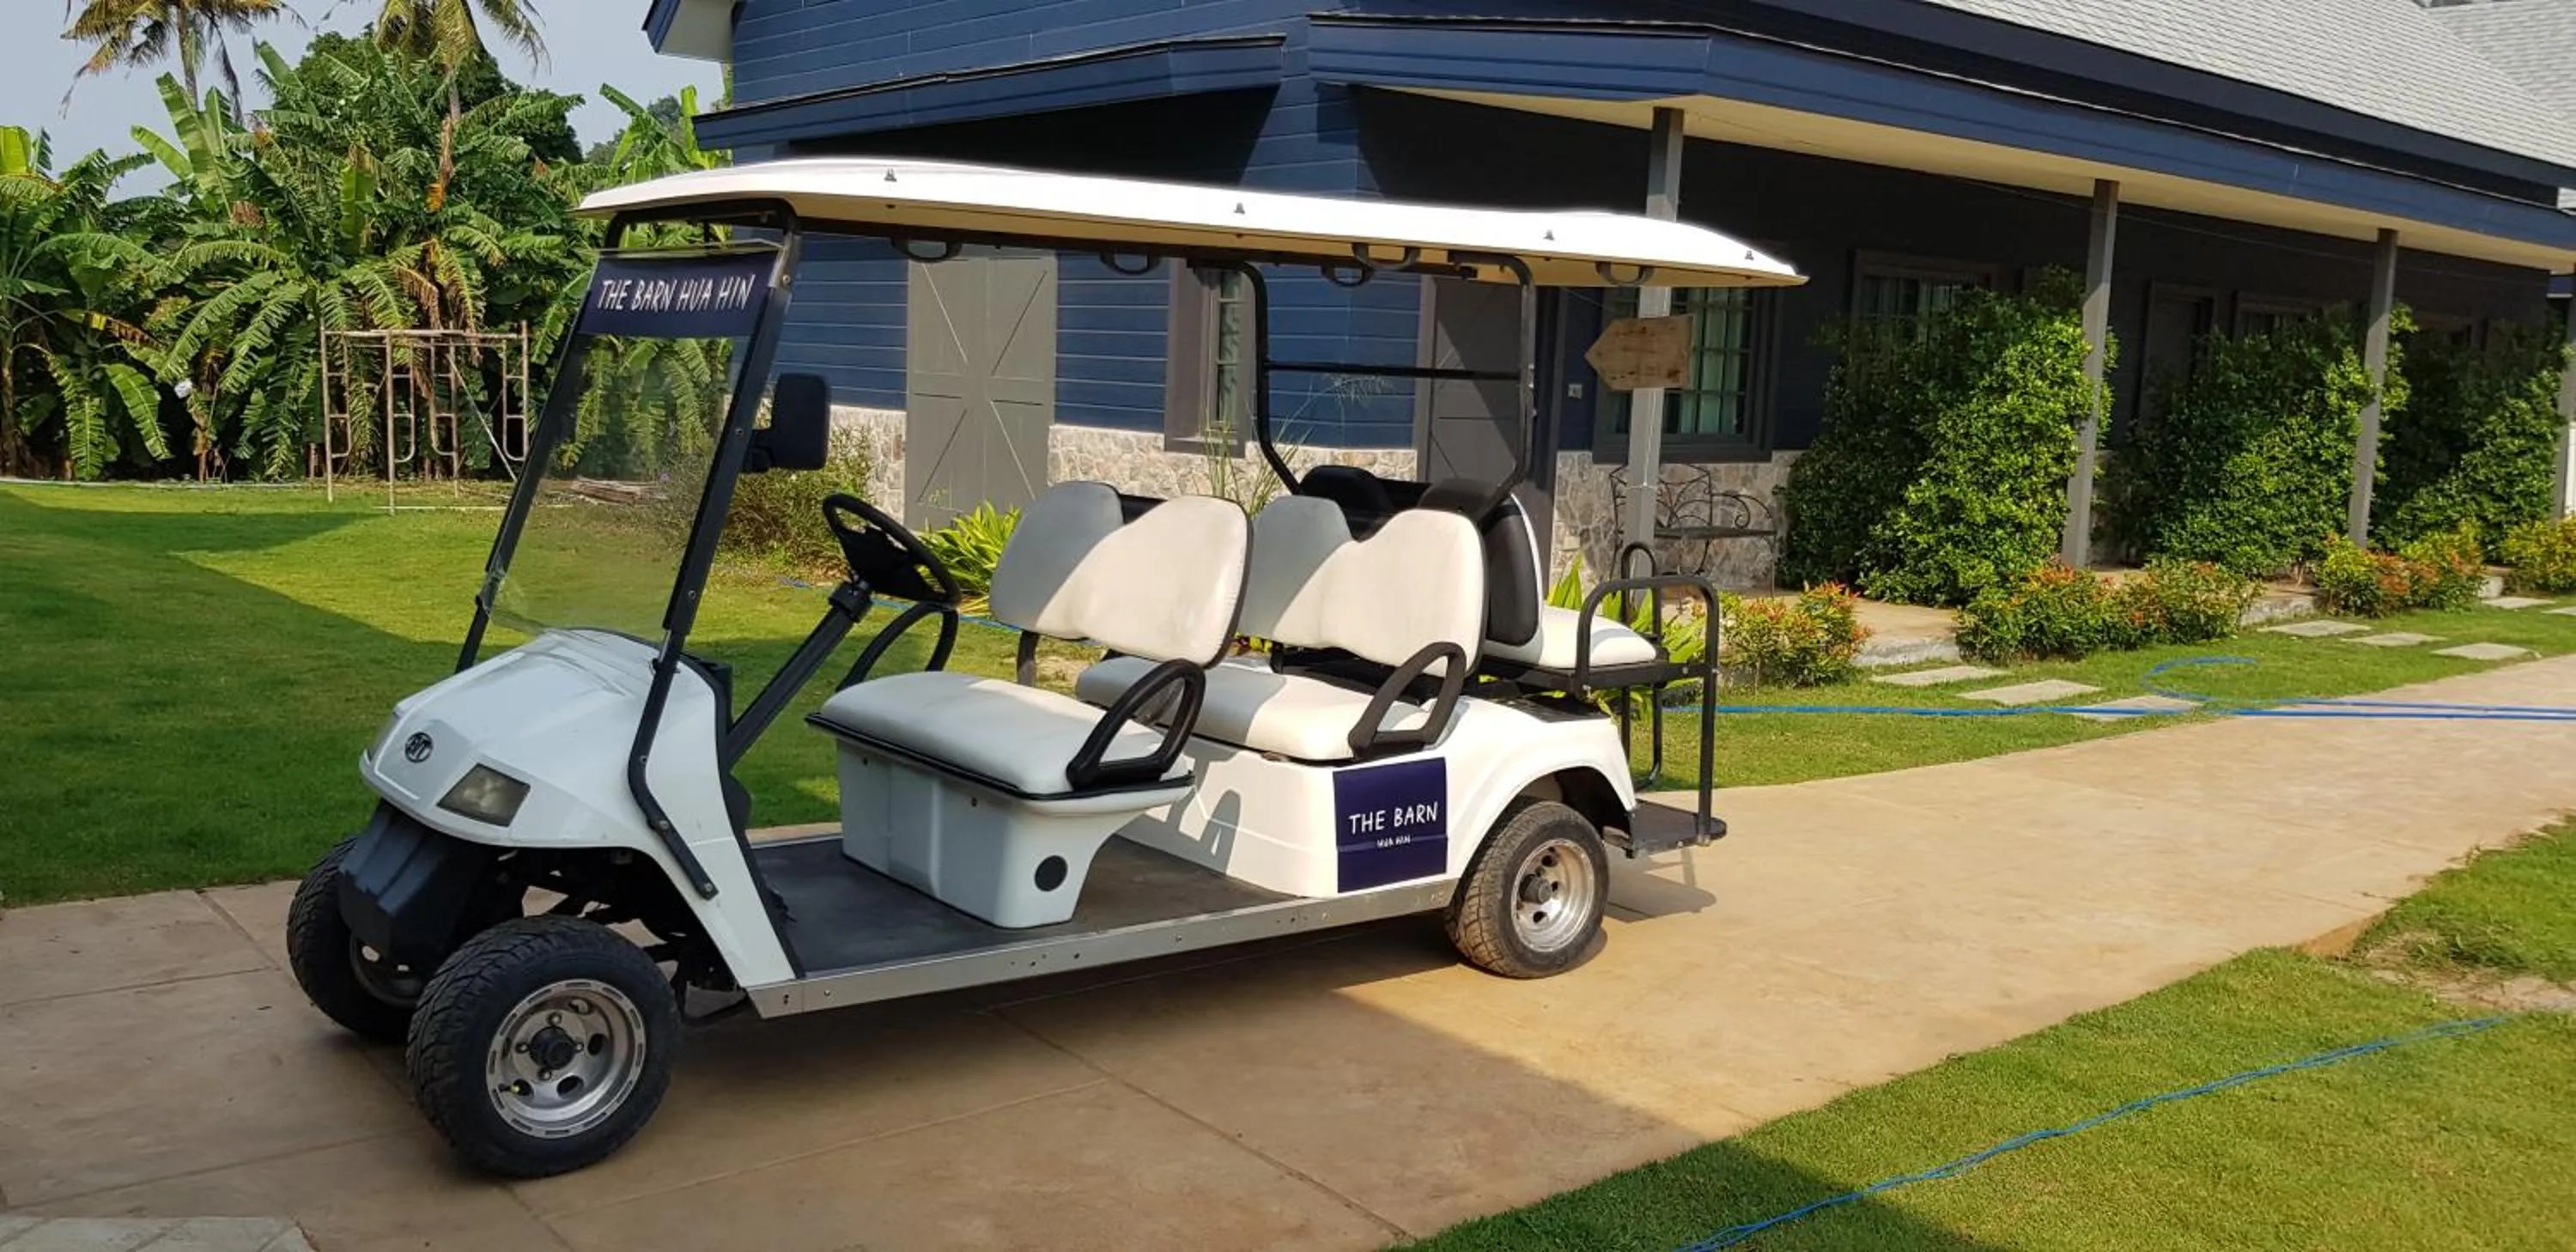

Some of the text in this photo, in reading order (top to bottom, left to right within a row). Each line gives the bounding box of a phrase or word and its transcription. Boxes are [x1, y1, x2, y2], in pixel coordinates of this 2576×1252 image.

[598, 274, 756, 313] THE BARN HUA HIN
[1348, 801, 1438, 835] THE BARN
